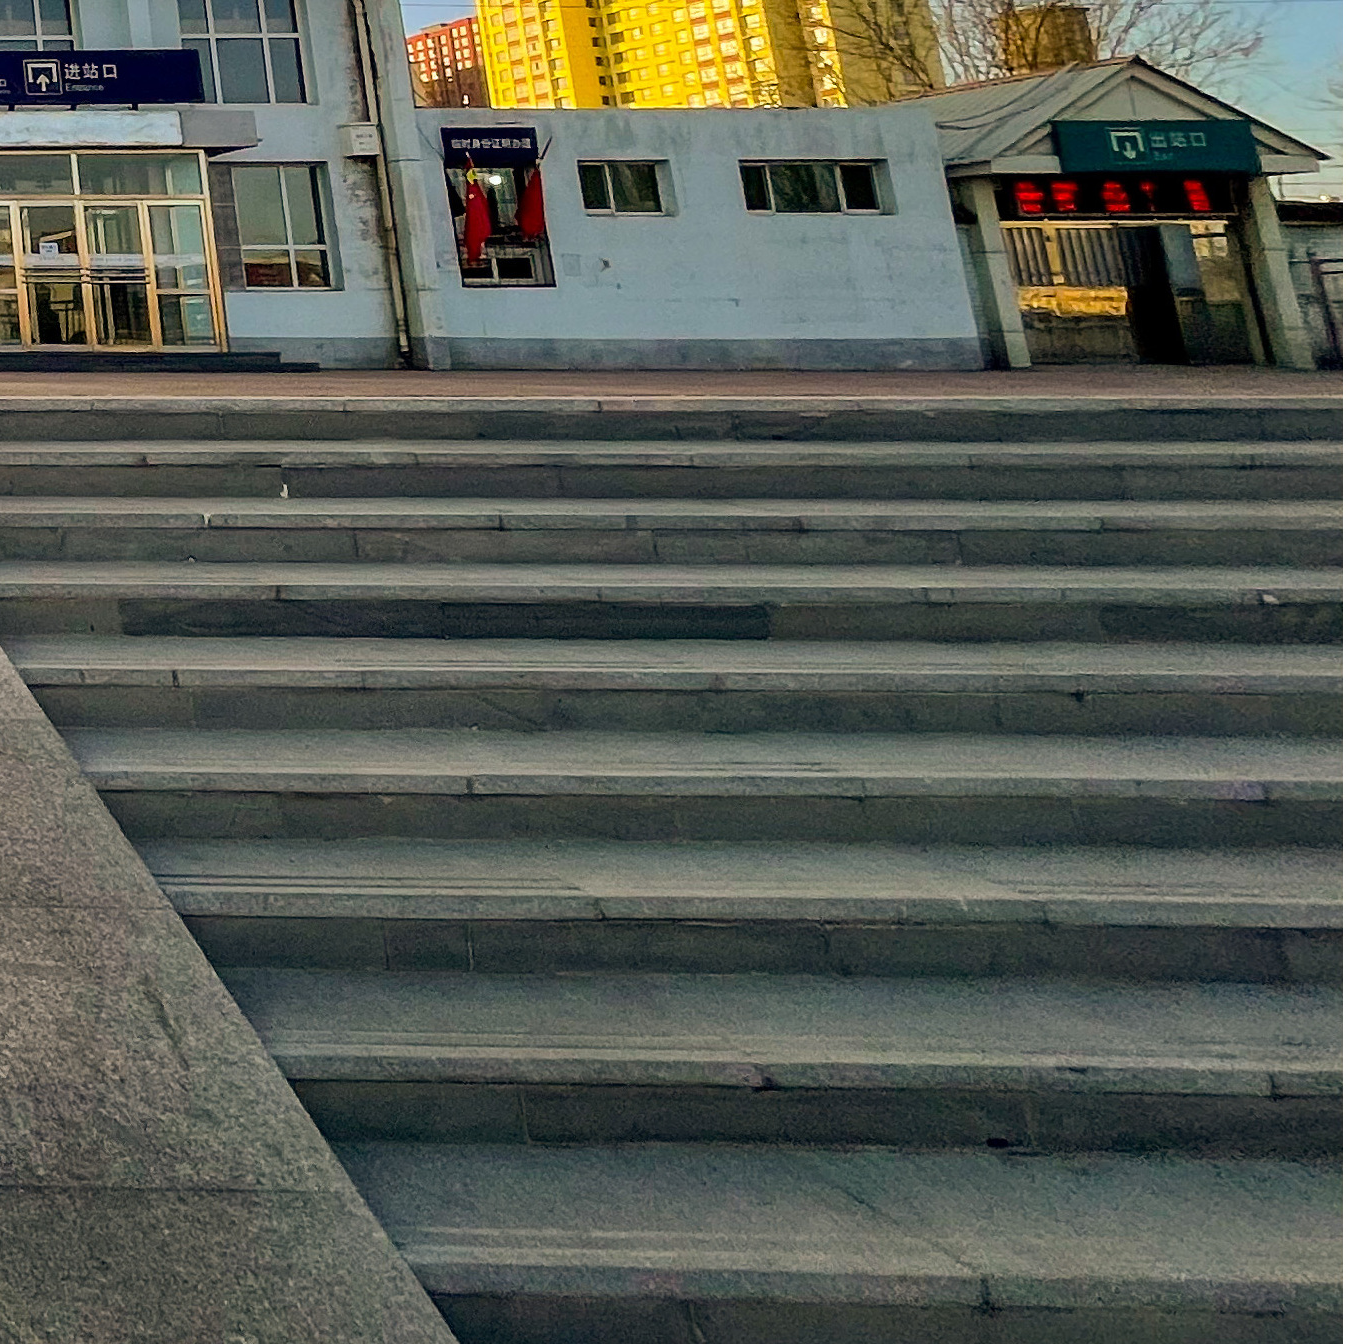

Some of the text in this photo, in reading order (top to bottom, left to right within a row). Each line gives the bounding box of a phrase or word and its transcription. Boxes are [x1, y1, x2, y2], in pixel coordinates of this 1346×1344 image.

[64, 63, 117, 79] 进站口
[1150, 131, 1207, 148] 出站口
